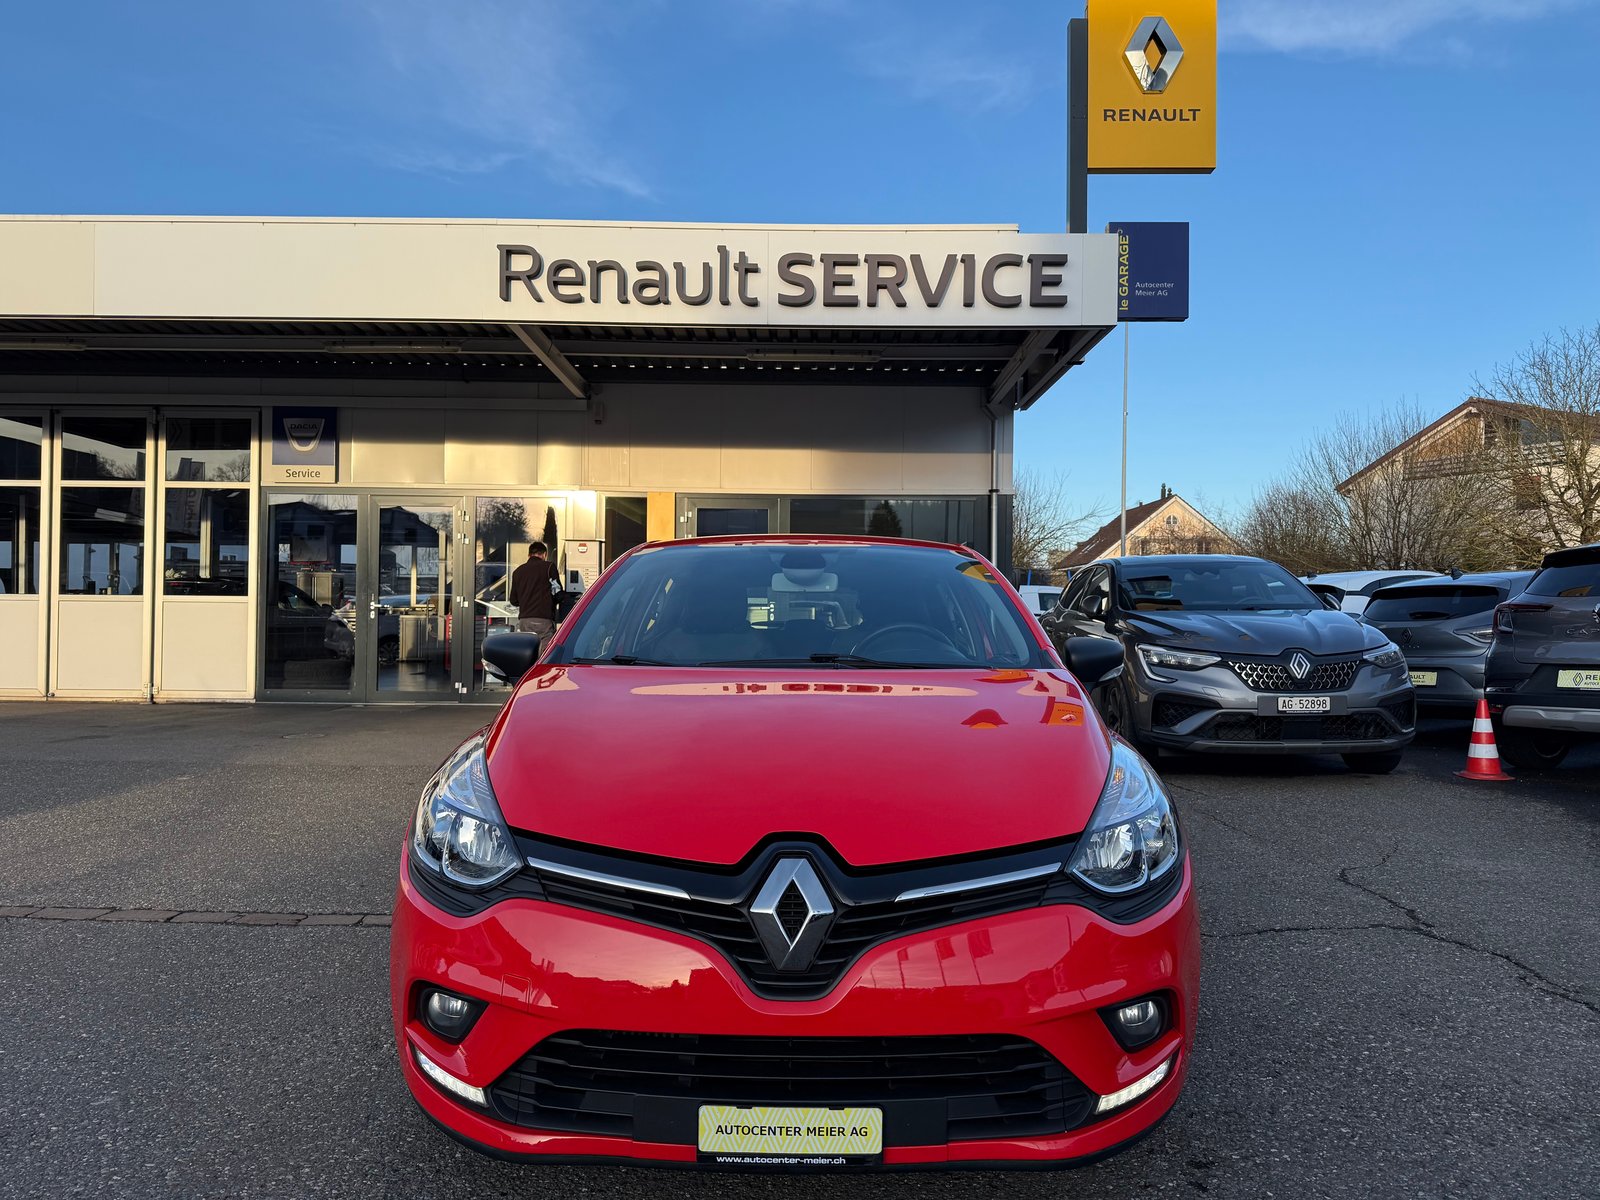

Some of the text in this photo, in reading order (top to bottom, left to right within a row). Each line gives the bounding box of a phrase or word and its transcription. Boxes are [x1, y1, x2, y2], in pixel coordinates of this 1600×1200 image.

[1103, 108, 1201, 122] RENAULT
[497, 244, 1069, 309] Renault SERVICE
[1119, 234, 1129, 311] le GARAGE
[1135, 281, 1175, 289] Autocenter
[1135, 289, 1168, 297] Meier AG
[285, 468, 321, 478] Service
[715, 1125, 868, 1137] AUTOCENTER MEIER AG
[716, 1155, 846, 1165] www.autocenter-meier.ch
